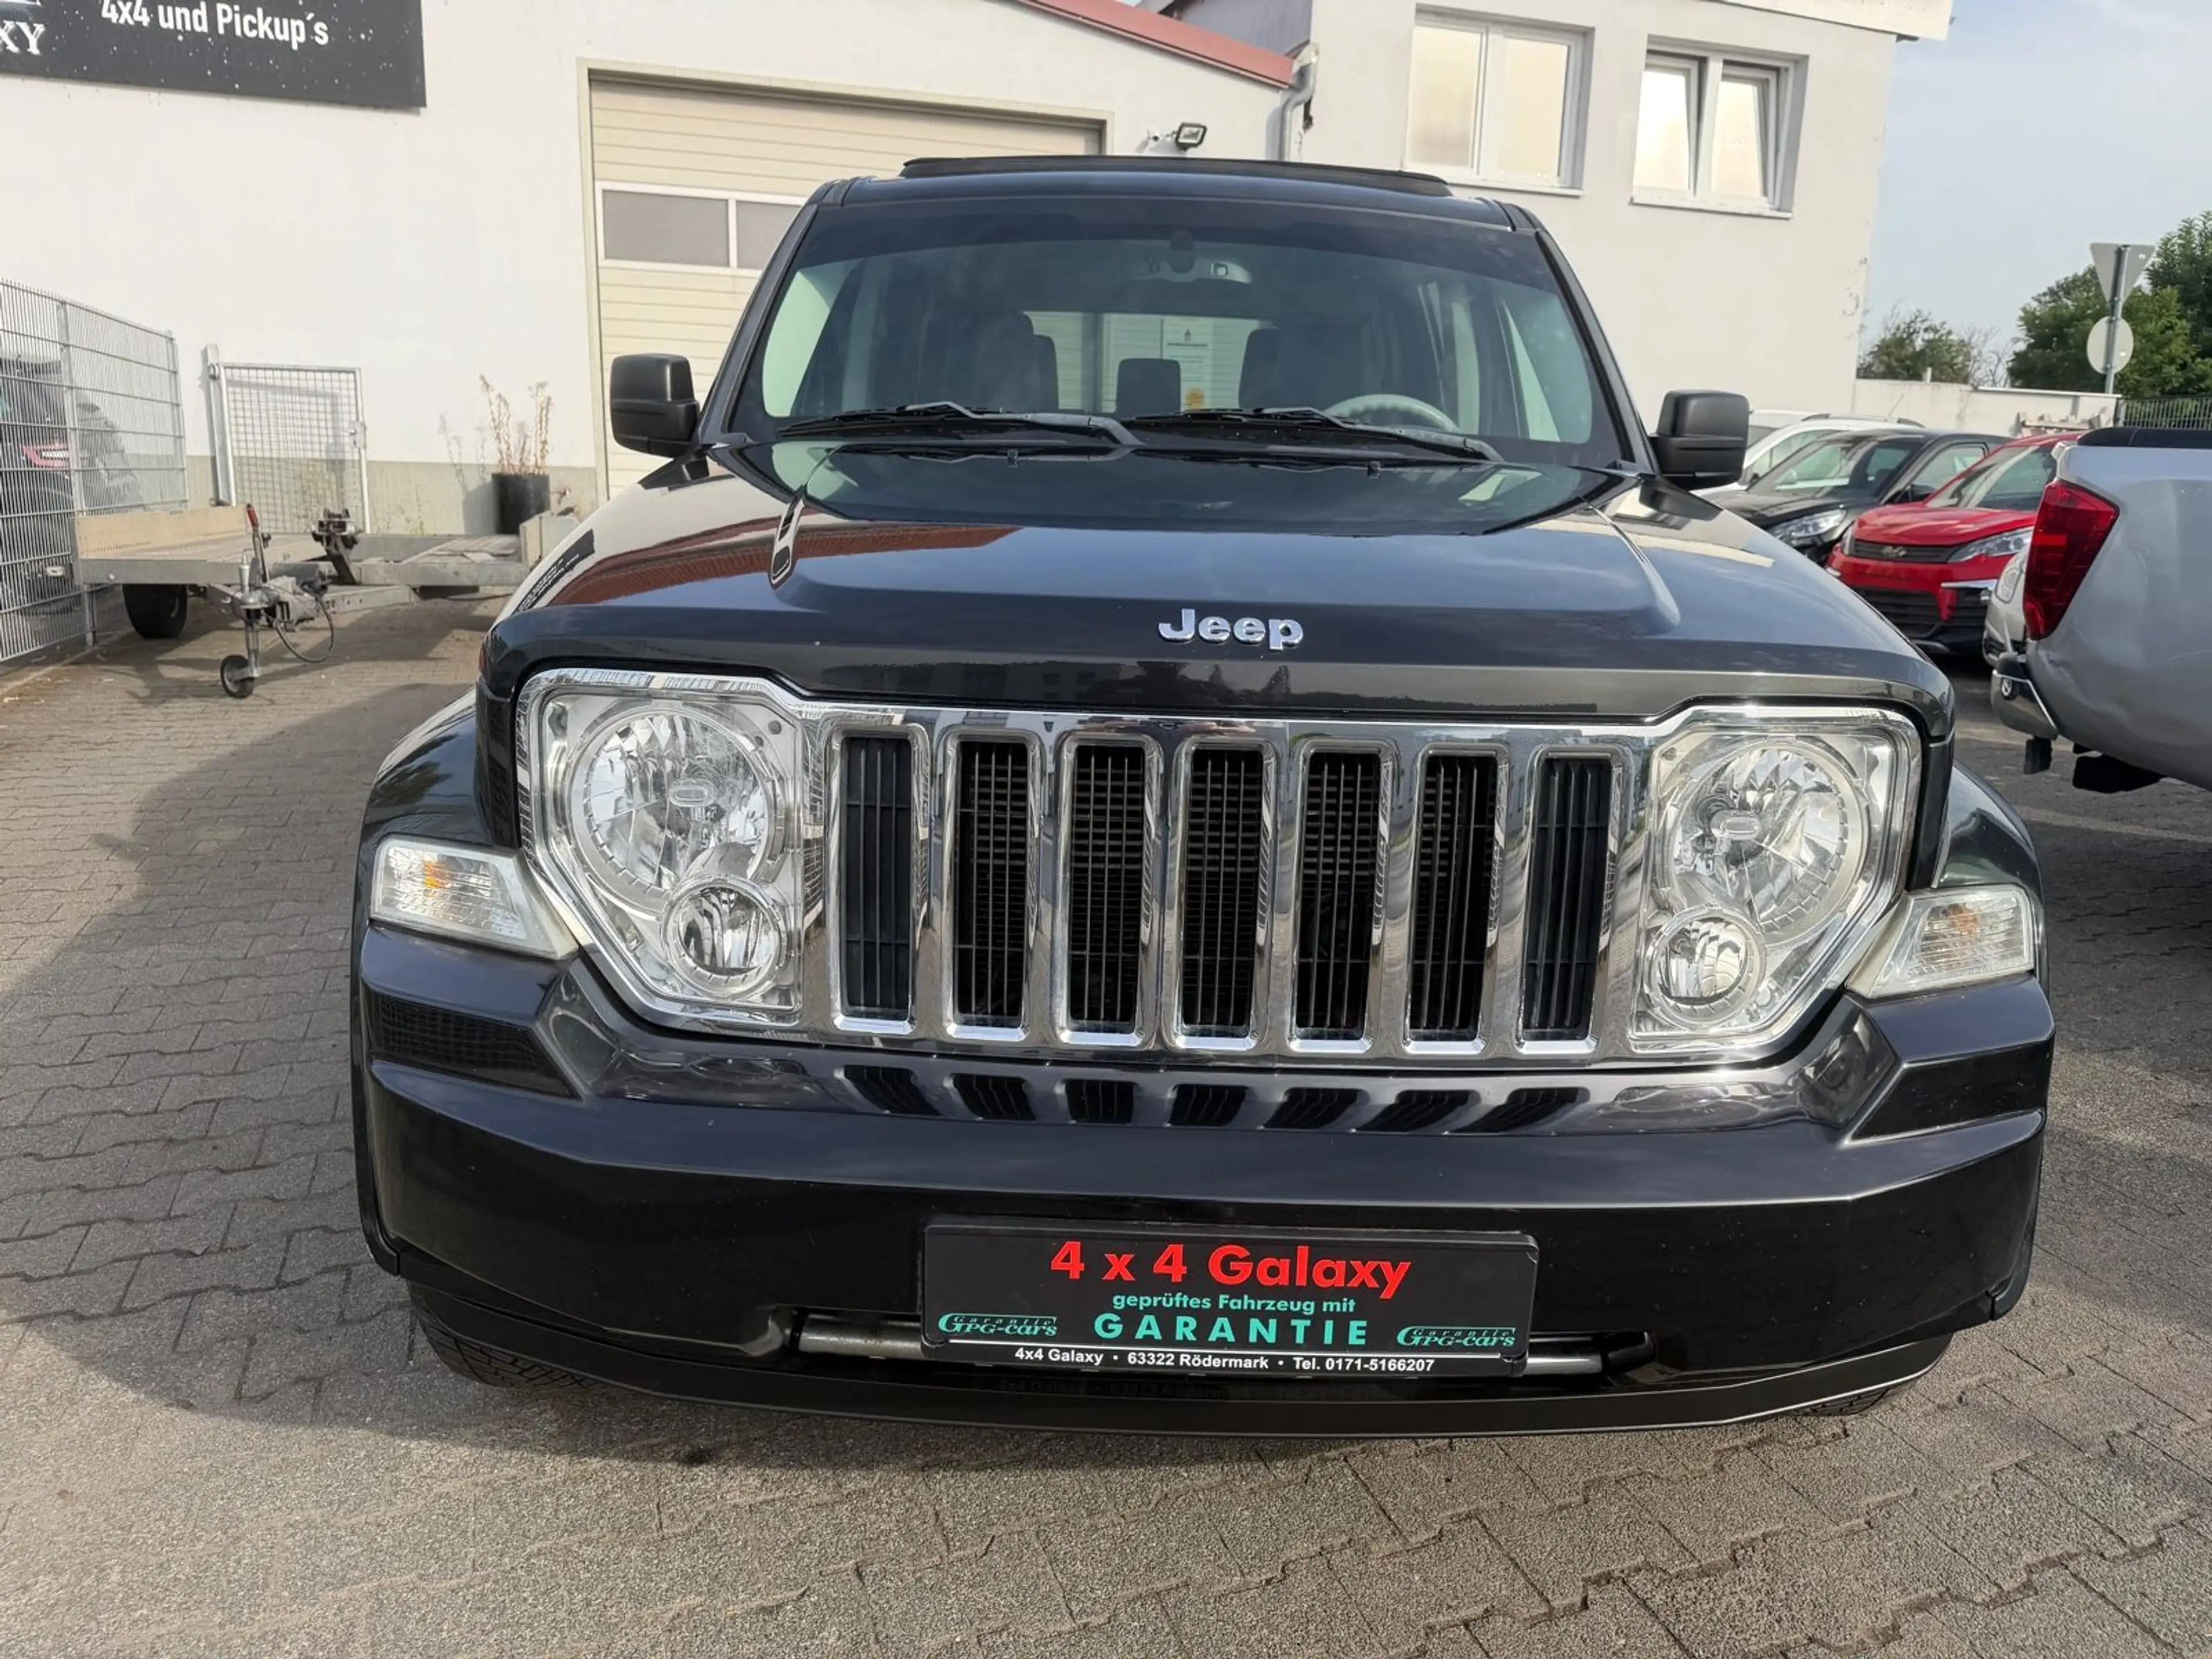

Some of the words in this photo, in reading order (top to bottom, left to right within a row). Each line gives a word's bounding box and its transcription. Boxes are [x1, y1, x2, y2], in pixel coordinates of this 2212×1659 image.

[158, 1, 209, 33] und
[1158, 608, 1304, 652] Jeep
[1050, 1241, 1085, 1279] 4
[1101, 1253, 1135, 1281] x
[1153, 1244, 1187, 1283] 4
[1208, 1244, 1411, 1300] Galaxy
[1112, 1291, 1211, 1310] geprüftes
[1218, 1294, 1315, 1315] Fahrzeug
[1323, 1298, 1356, 1313] mit
[1094, 1312, 1368, 1345] GARANTIE
[1014, 1347, 1043, 1360] 4x4
[1048, 1349, 1104, 1366] Galaxy
[1127, 1351, 1175, 1366] 63322
[1179, 1353, 1269, 1369] Rödermark
[1293, 1357, 1320, 1370] Tel.
[1325, 1358, 1435, 1372] 0171-5166207
